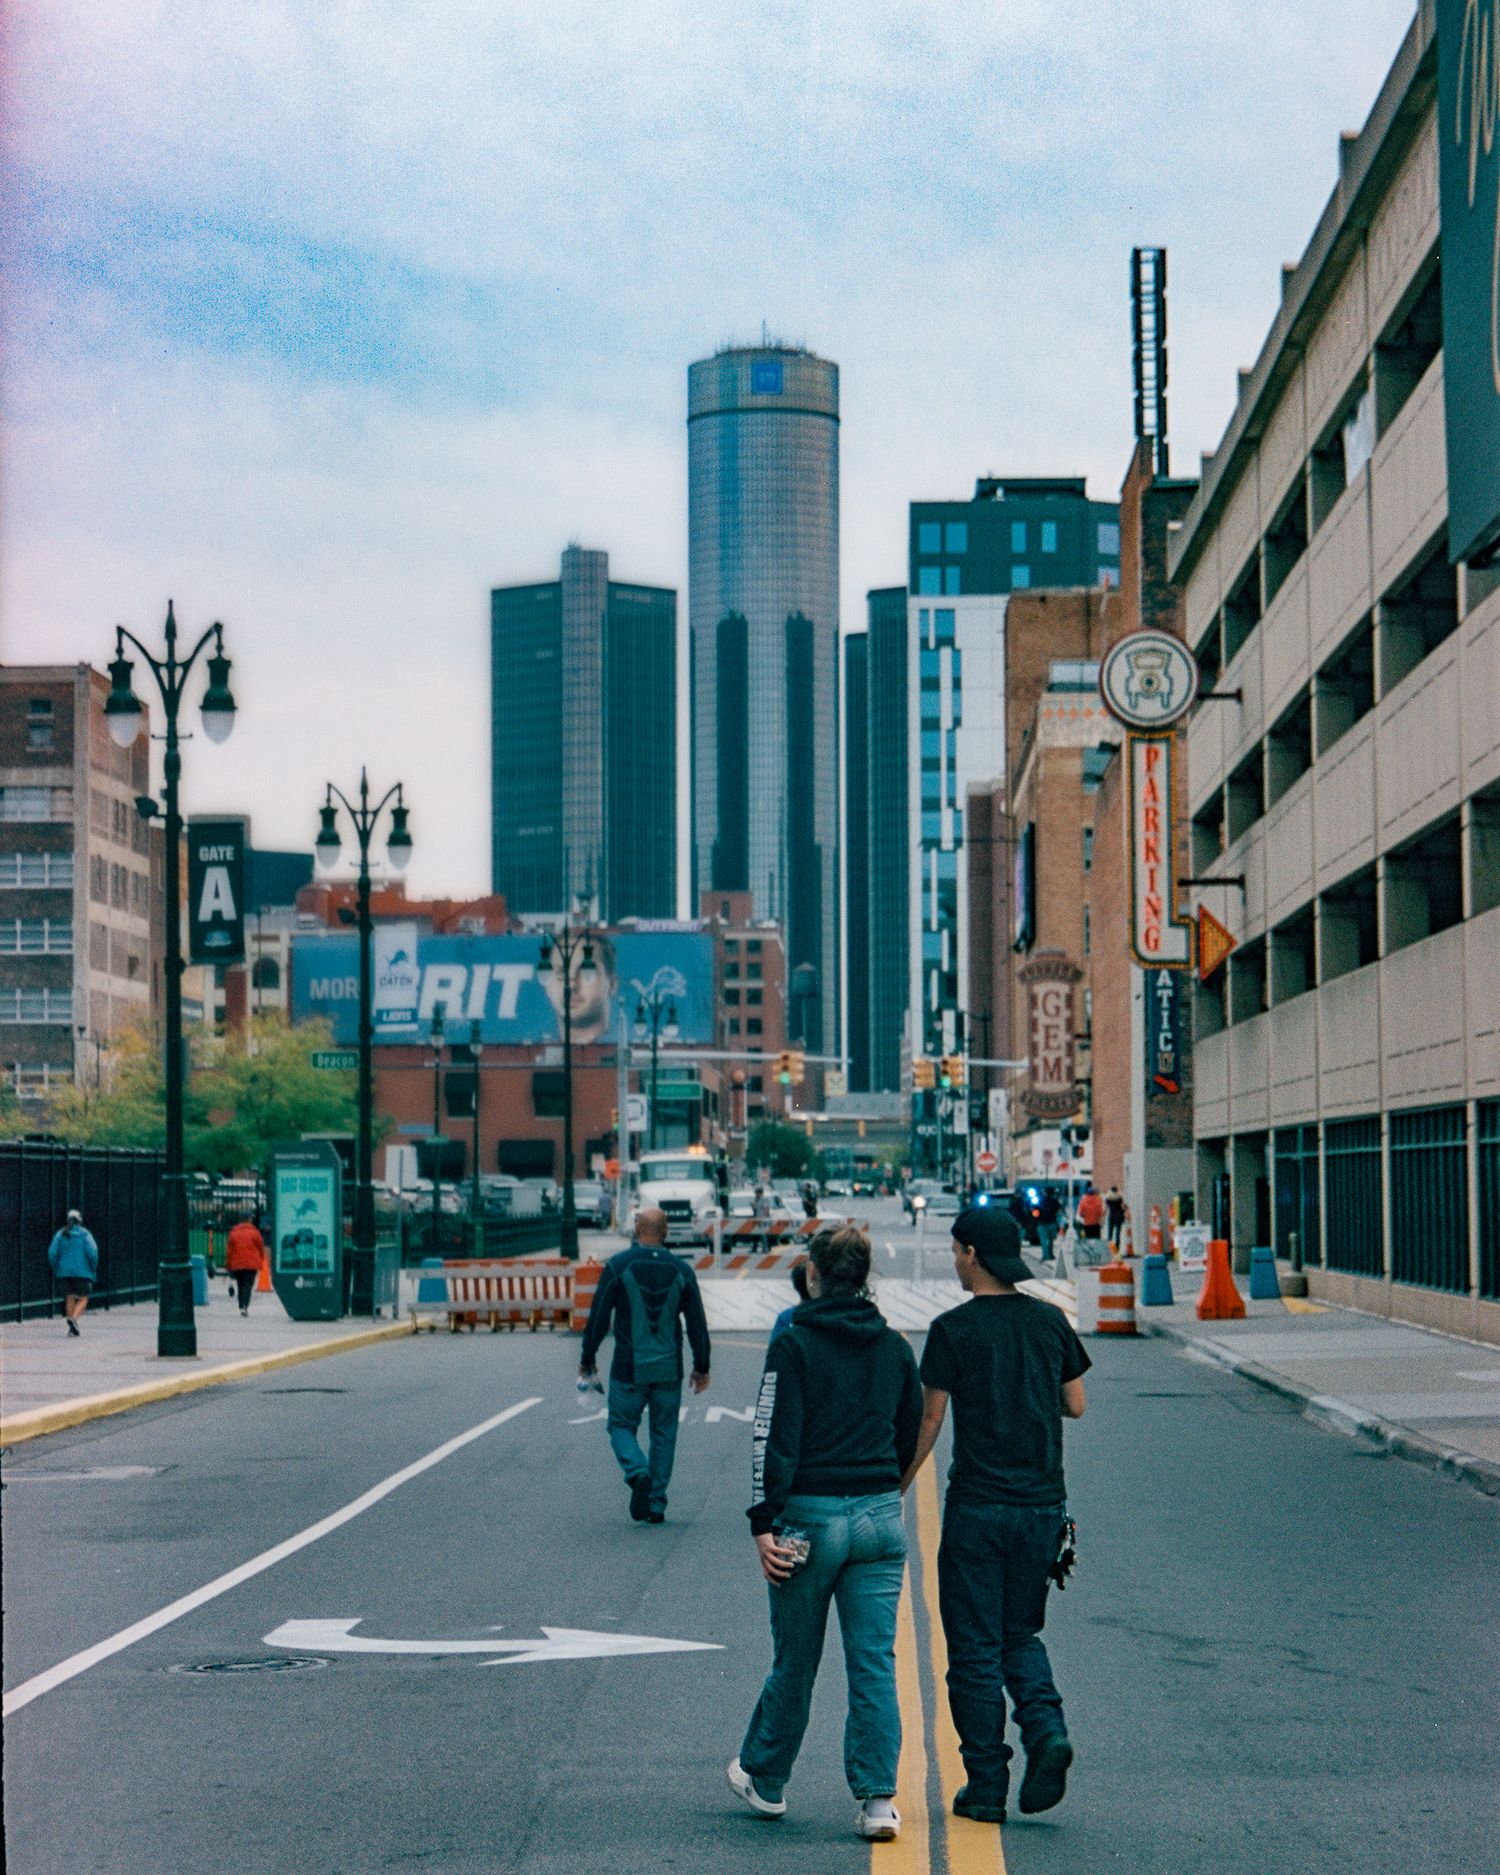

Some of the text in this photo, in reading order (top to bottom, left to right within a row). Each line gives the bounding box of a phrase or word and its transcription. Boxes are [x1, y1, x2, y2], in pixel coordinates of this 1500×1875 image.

[199, 845, 235, 861] GATE
[1144, 746, 1161, 952] PARKING
[198, 866, 237, 921] A
[310, 963, 534, 1019] MOR RIT
[317, 1055, 354, 1068] Beacon
[1042, 990, 1062, 1083] GEM
[753, 1372, 778, 1438] DUNDER
